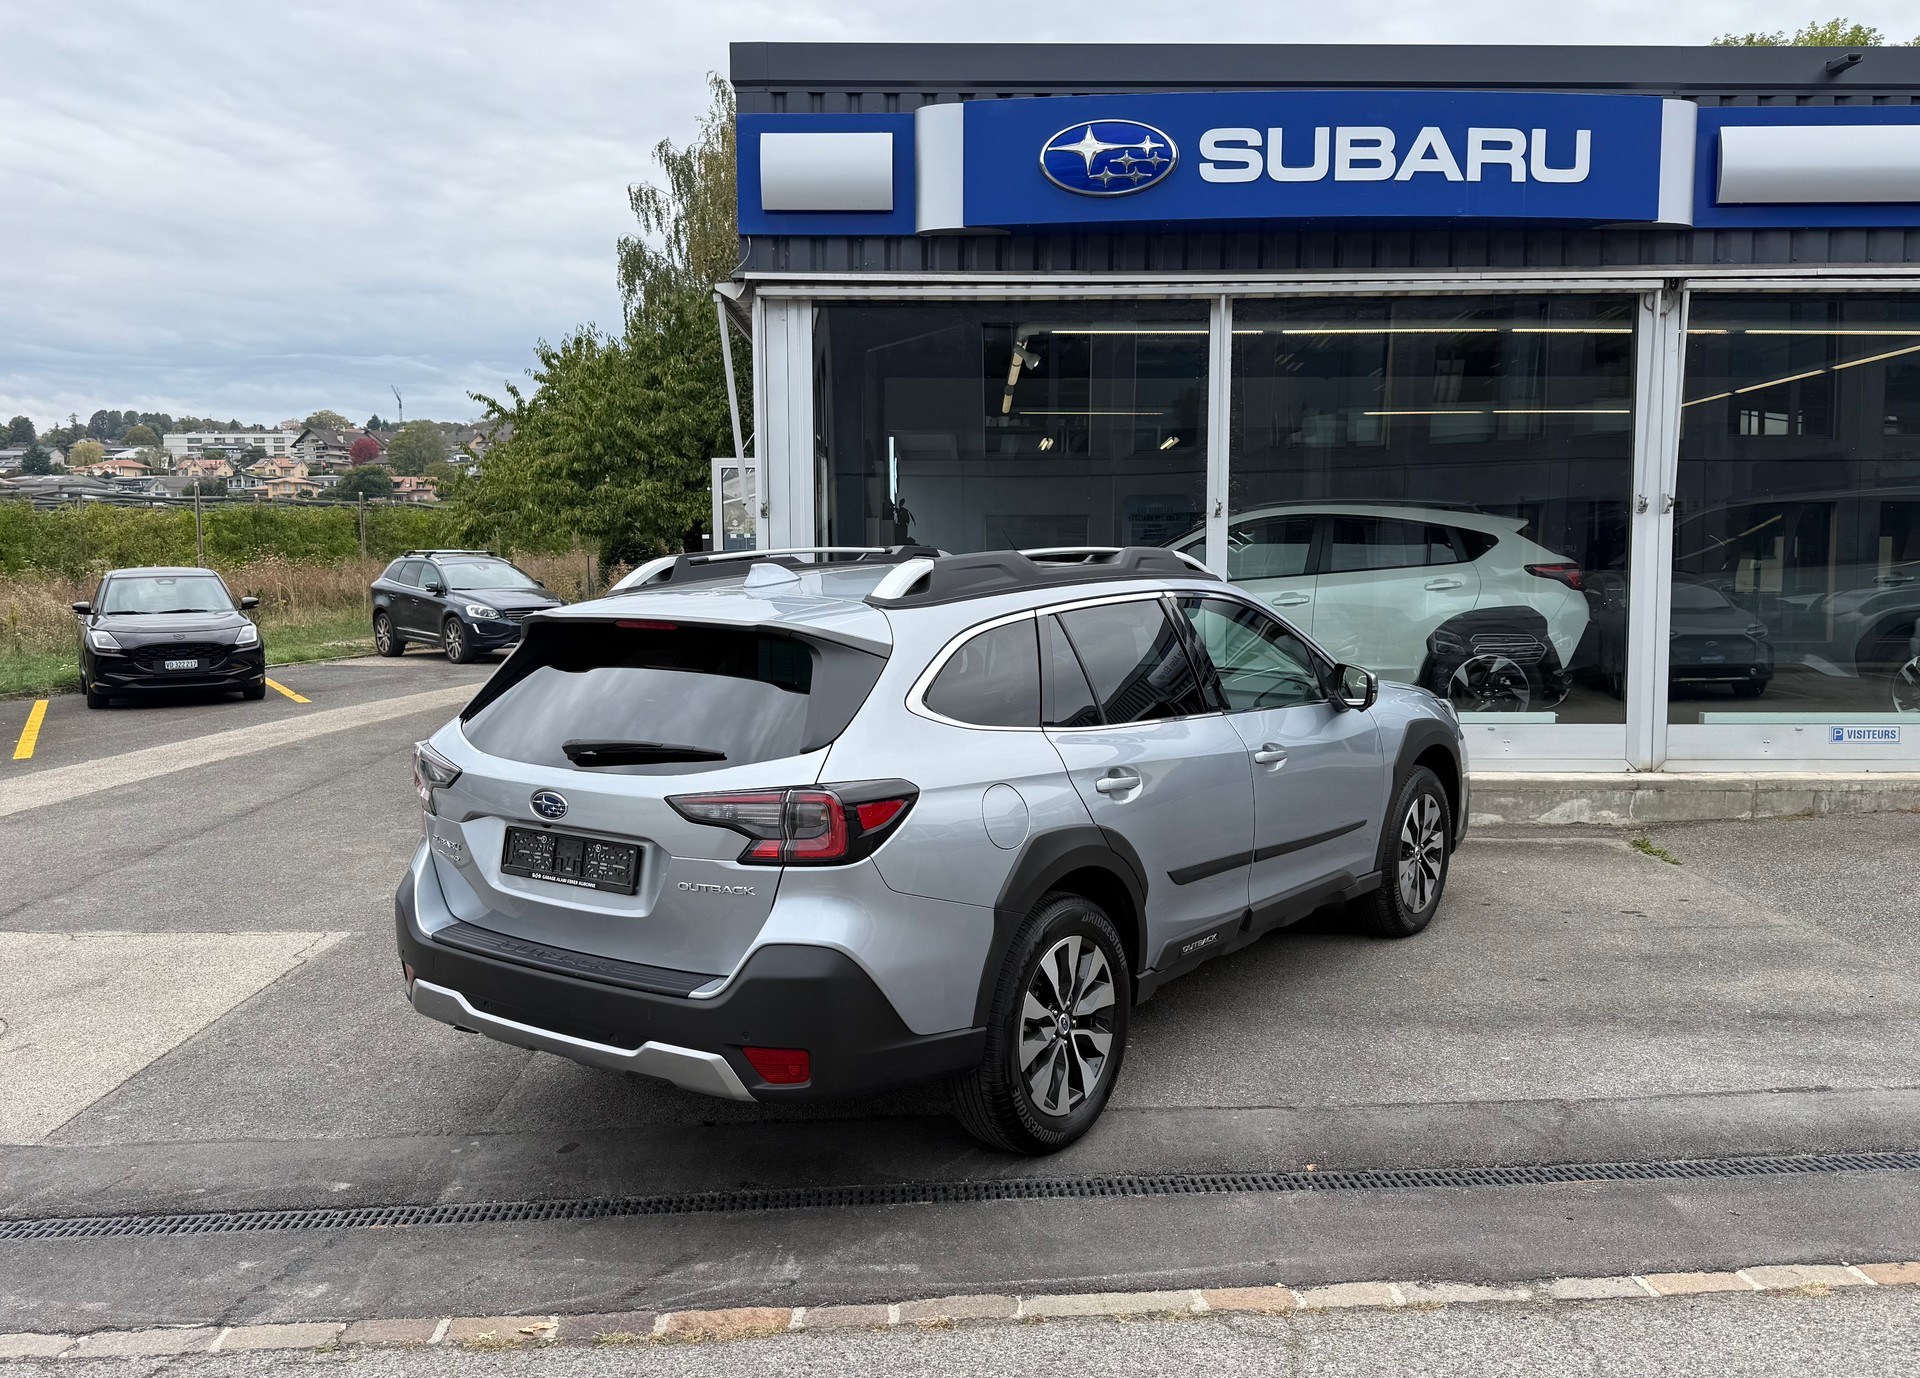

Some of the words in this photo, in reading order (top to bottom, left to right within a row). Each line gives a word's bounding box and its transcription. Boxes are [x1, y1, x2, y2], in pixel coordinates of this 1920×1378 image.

[1199, 126, 1591, 183] SUBARU
[1847, 729, 1896, 739] VISITEURS
[678, 882, 756, 896] OUTBACK
[1081, 910, 1127, 971] BRIDGESTONE
[1182, 933, 1218, 953] OUTBACK
[1011, 1087, 1066, 1144] BRIDGESTONE
